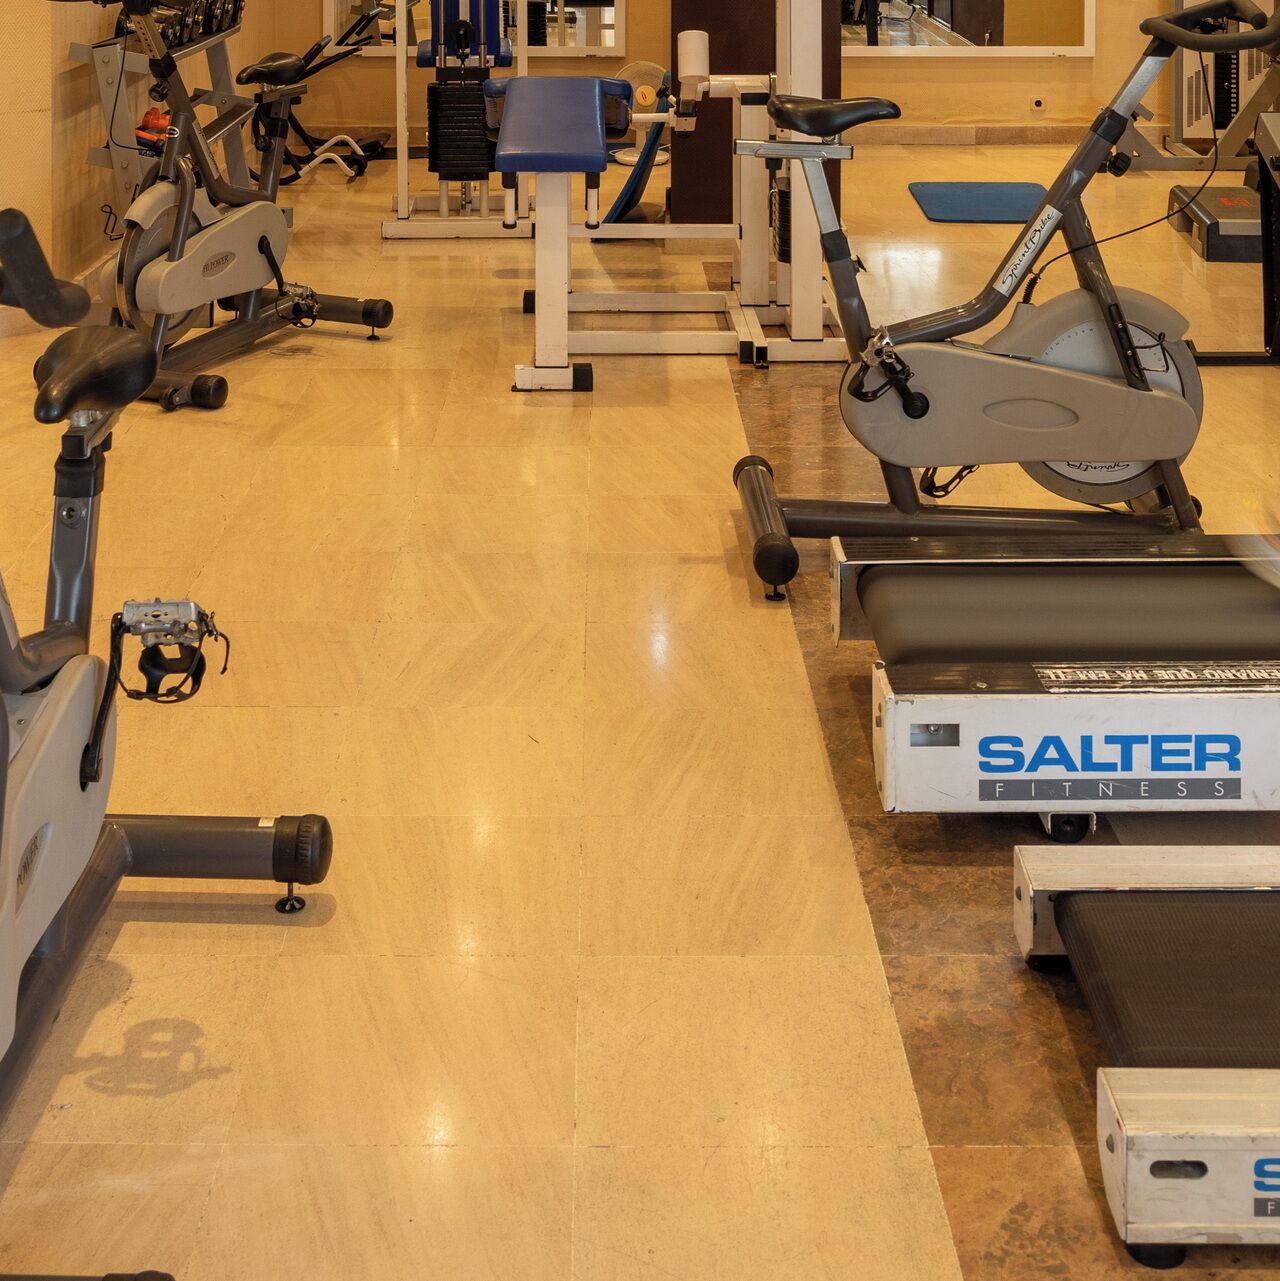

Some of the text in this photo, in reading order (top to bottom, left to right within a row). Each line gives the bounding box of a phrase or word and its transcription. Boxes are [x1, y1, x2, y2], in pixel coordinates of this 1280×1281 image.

[1076, 669, 1110, 681] EM
[1152, 667, 1197, 680] QUE
[978, 734, 1241, 773] SALTER
[995, 781, 1225, 797] FITNESS
